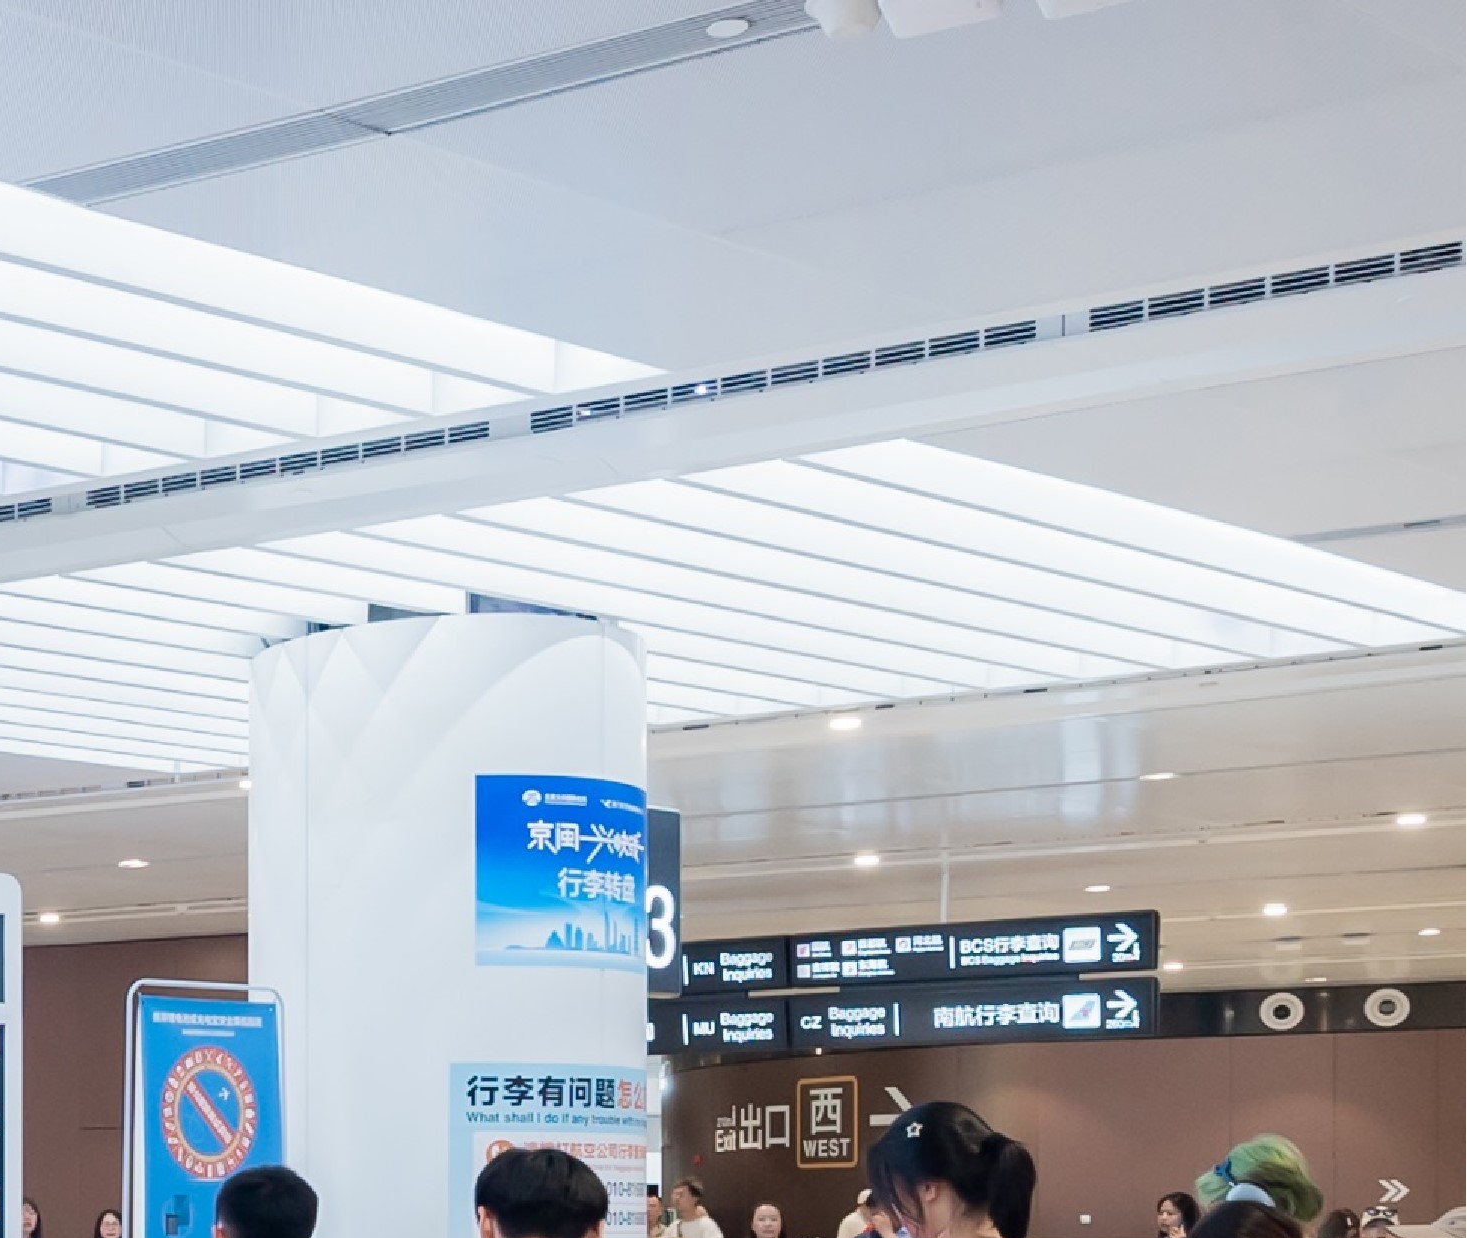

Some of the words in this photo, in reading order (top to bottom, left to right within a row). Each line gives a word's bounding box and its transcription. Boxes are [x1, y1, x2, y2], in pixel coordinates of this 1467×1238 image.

[557, 867, 635, 904] 行李转盘
[959, 932, 1060, 954] BCS行李查询
[692, 961, 716, 975] KN
[719, 951, 774, 968] Baggage
[722, 967, 773, 983] Inquiries
[692, 1020, 716, 1036] MU
[719, 1011, 774, 1028] Baggage
[800, 1015, 823, 1030] CZ
[827, 1006, 886, 1023] Baggage
[932, 1000, 1060, 1030] 南航行李查询
[722, 1029, 774, 1044] Inquiries
[830, 1022, 886, 1040] Inquiries
[466, 1111, 500, 1124] What
[504, 1111, 535, 1124] shall
[544, 1111, 559, 1124] do
[571, 1114, 589, 1127] any
[809, 1087, 843, 1136] 西
[802, 1138, 852, 1158] WEST
